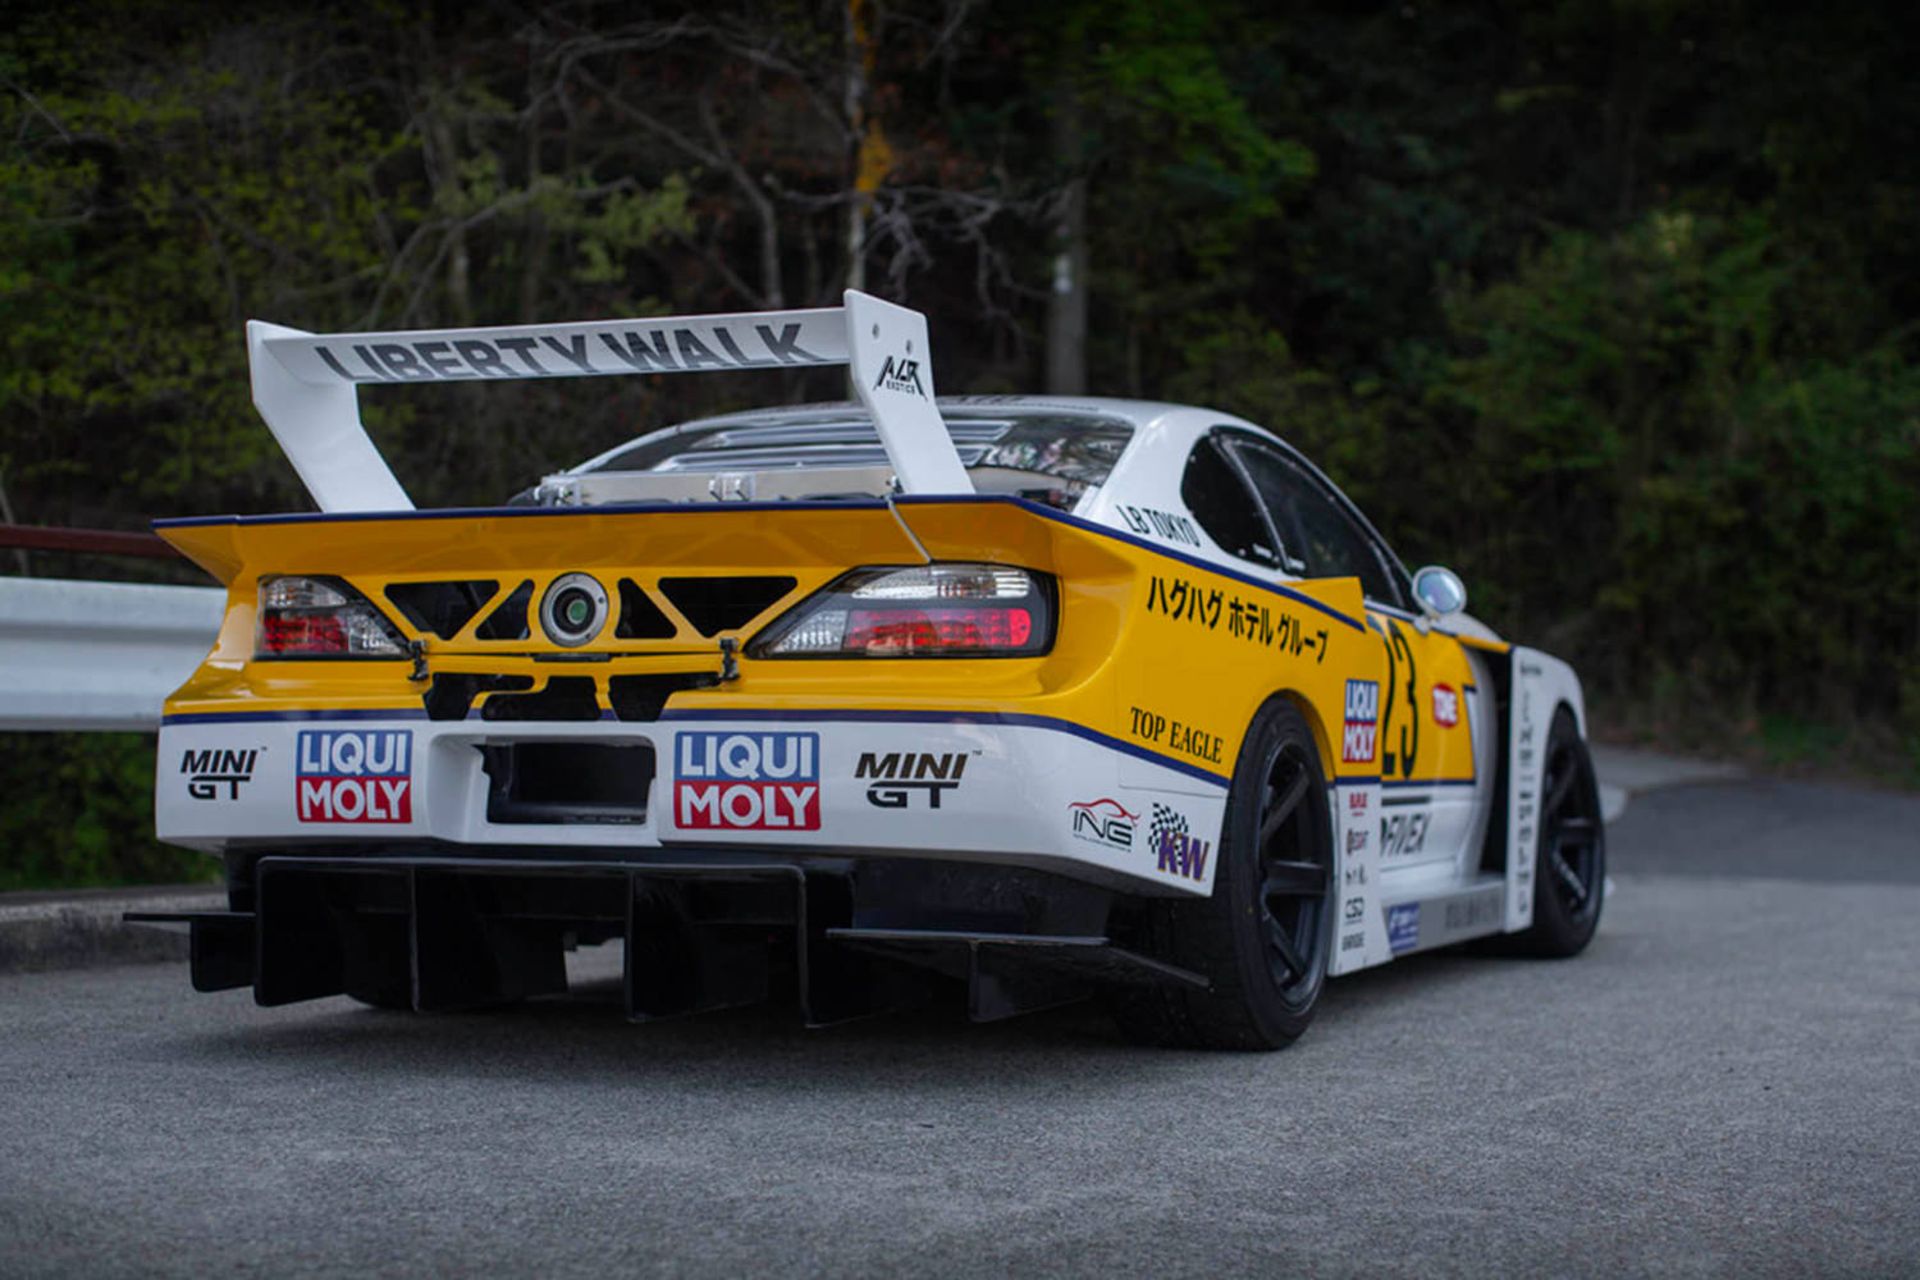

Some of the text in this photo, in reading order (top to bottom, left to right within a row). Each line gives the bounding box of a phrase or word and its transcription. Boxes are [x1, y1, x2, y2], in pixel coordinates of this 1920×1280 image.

[314, 323, 832, 382] LIBERTY WALK
[1115, 505, 1201, 548] LB TOKYO
[1147, 576, 1330, 665] ハグハグ ホテル グループ
[301, 733, 408, 776] LIQUI
[680, 734, 814, 780] LIQUI
[1131, 706, 1224, 765] TOP EAGLE
[1343, 723, 1377, 762] MOLY
[180, 749, 258, 774] MINI
[855, 752, 969, 780] MINI
[188, 775, 251, 801] GT
[301, 779, 410, 821] MOLY
[680, 783, 818, 827] MOLY
[866, 781, 960, 809] GT
[1157, 828, 1211, 883] KW
